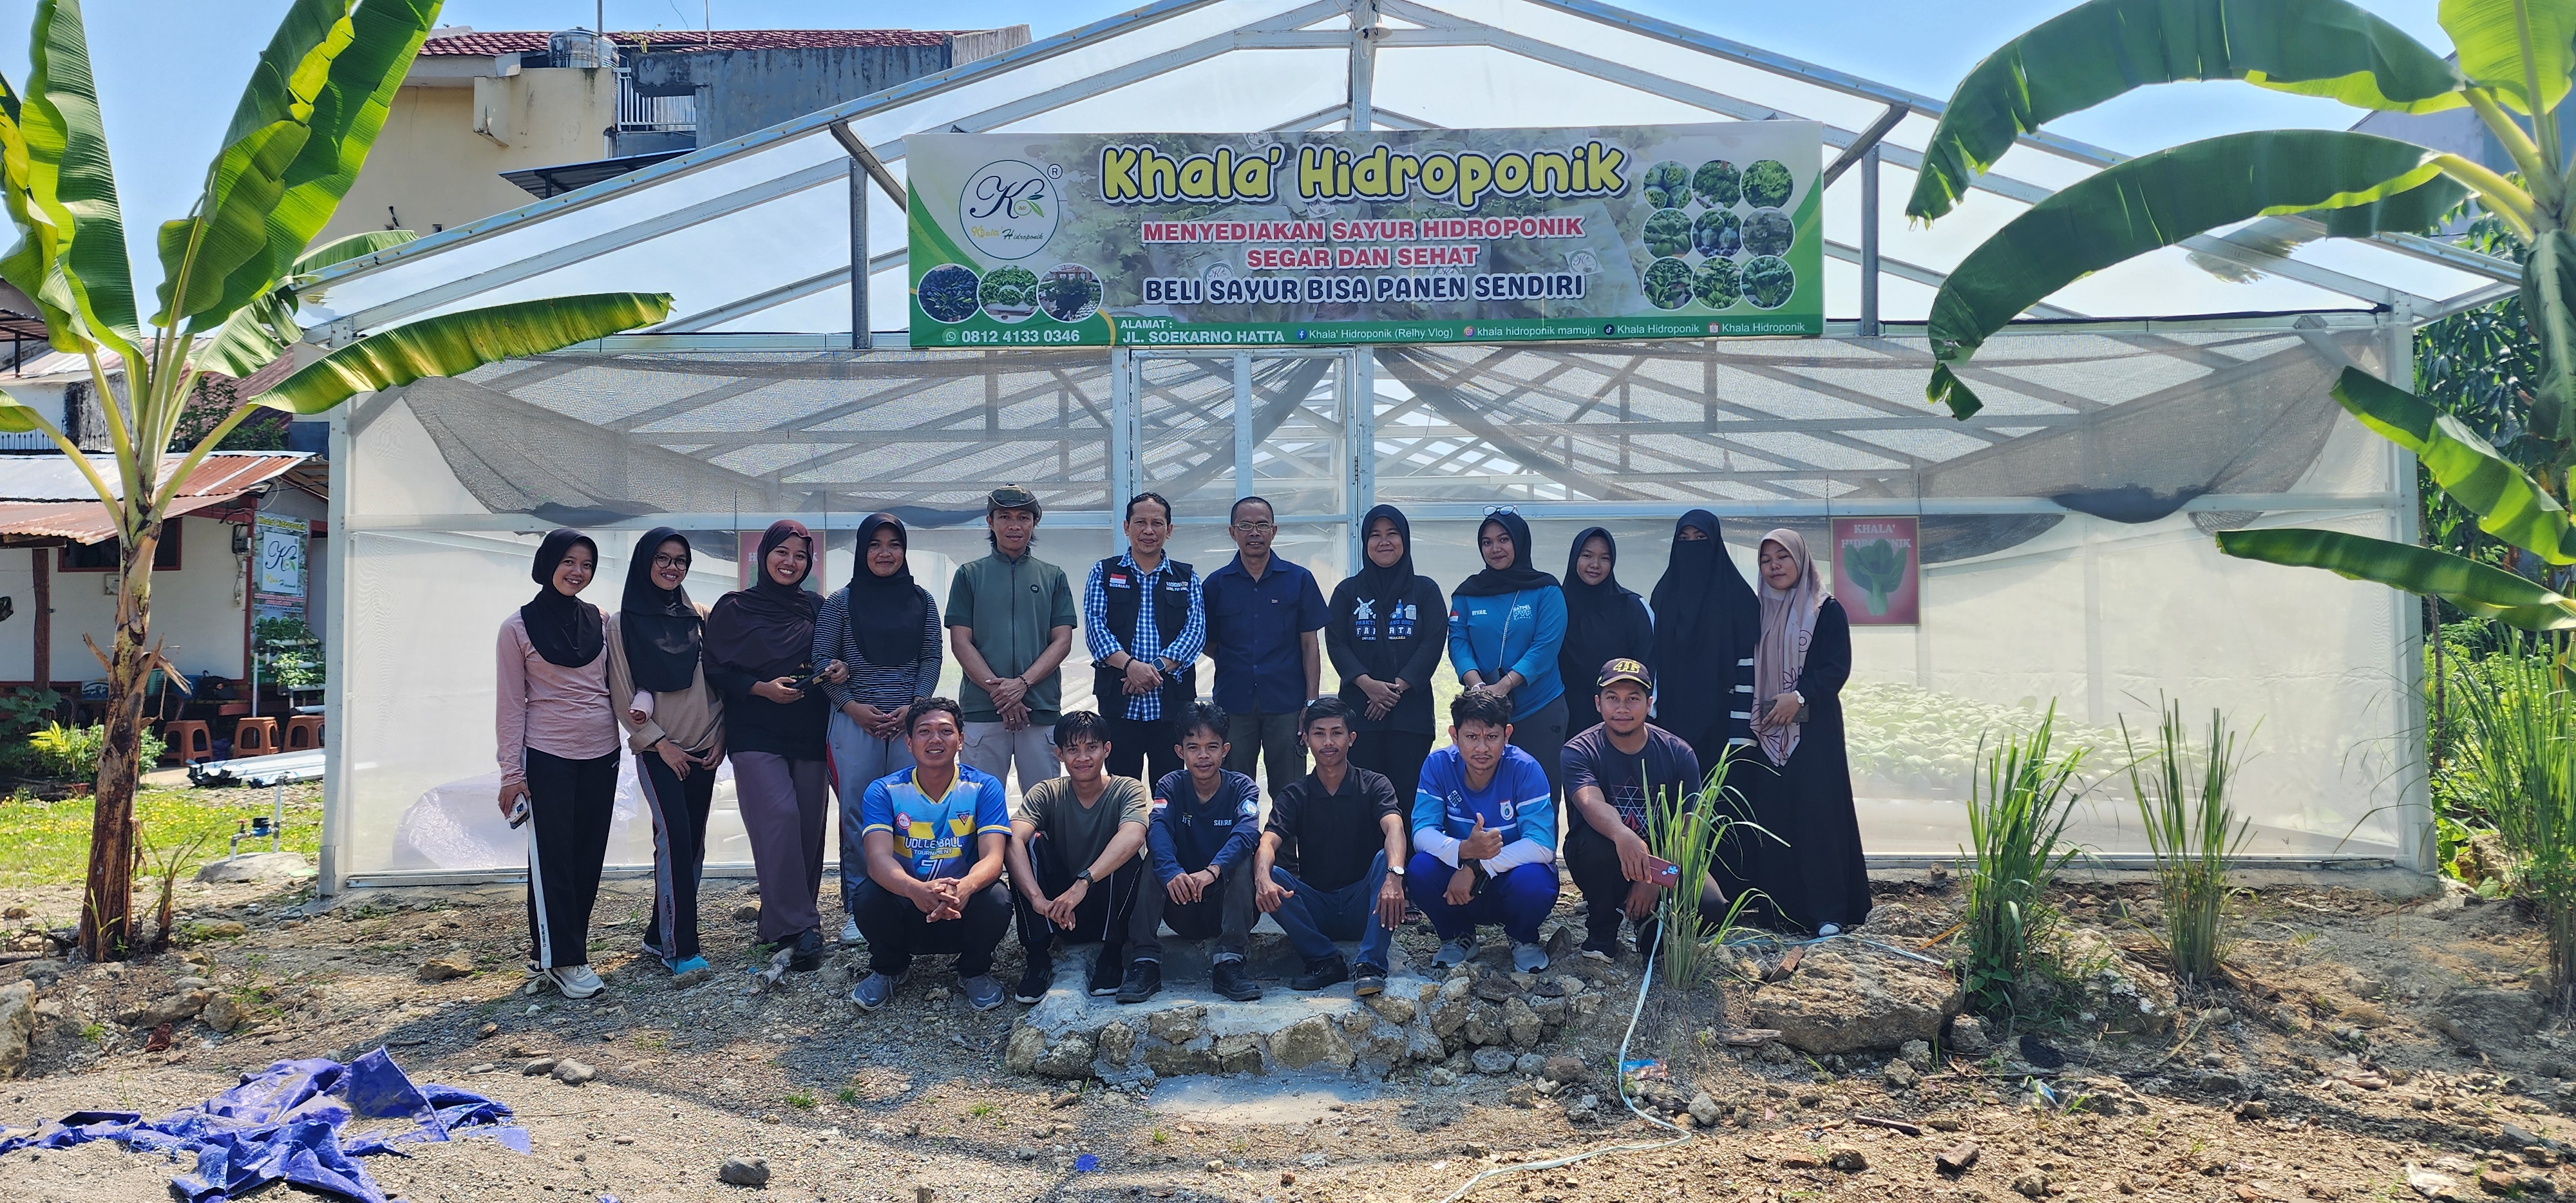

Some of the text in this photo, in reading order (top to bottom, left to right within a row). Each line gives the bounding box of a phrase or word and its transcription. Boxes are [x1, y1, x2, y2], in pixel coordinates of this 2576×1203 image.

[1103, 140, 1627, 208] Khala' Hidroponik
[1002, 229, 1043, 240] Hidroponik
[1143, 218, 1584, 241] MENYEDIAKAN SAYUR HIDROPONIK
[1247, 247, 1478, 267] SEGAR DAN SEHAT
[1146, 275, 1582, 301] BELI SAYUR BISA PANEN SENDIRI
[1120, 319, 1166, 329] ALAMAT
[1617, 323, 1700, 335] Khala Hidroponik
[1722, 322, 1805, 334] Khala Hidroponik
[961, 329, 1080, 343] 0812 4133 0346
[1122, 330, 1285, 343] JL. SOEKARNO HATTA
[1309, 328, 1454, 340] Khala' Hidroponik (Relhy Vlog)
[1477, 325, 1596, 337] khala hidroponik mamuju
[1853, 524, 1895, 534] KHALA'
[1841, 538, 1912, 549] HIDRONIK
[1612, 661, 1641, 674] 46
